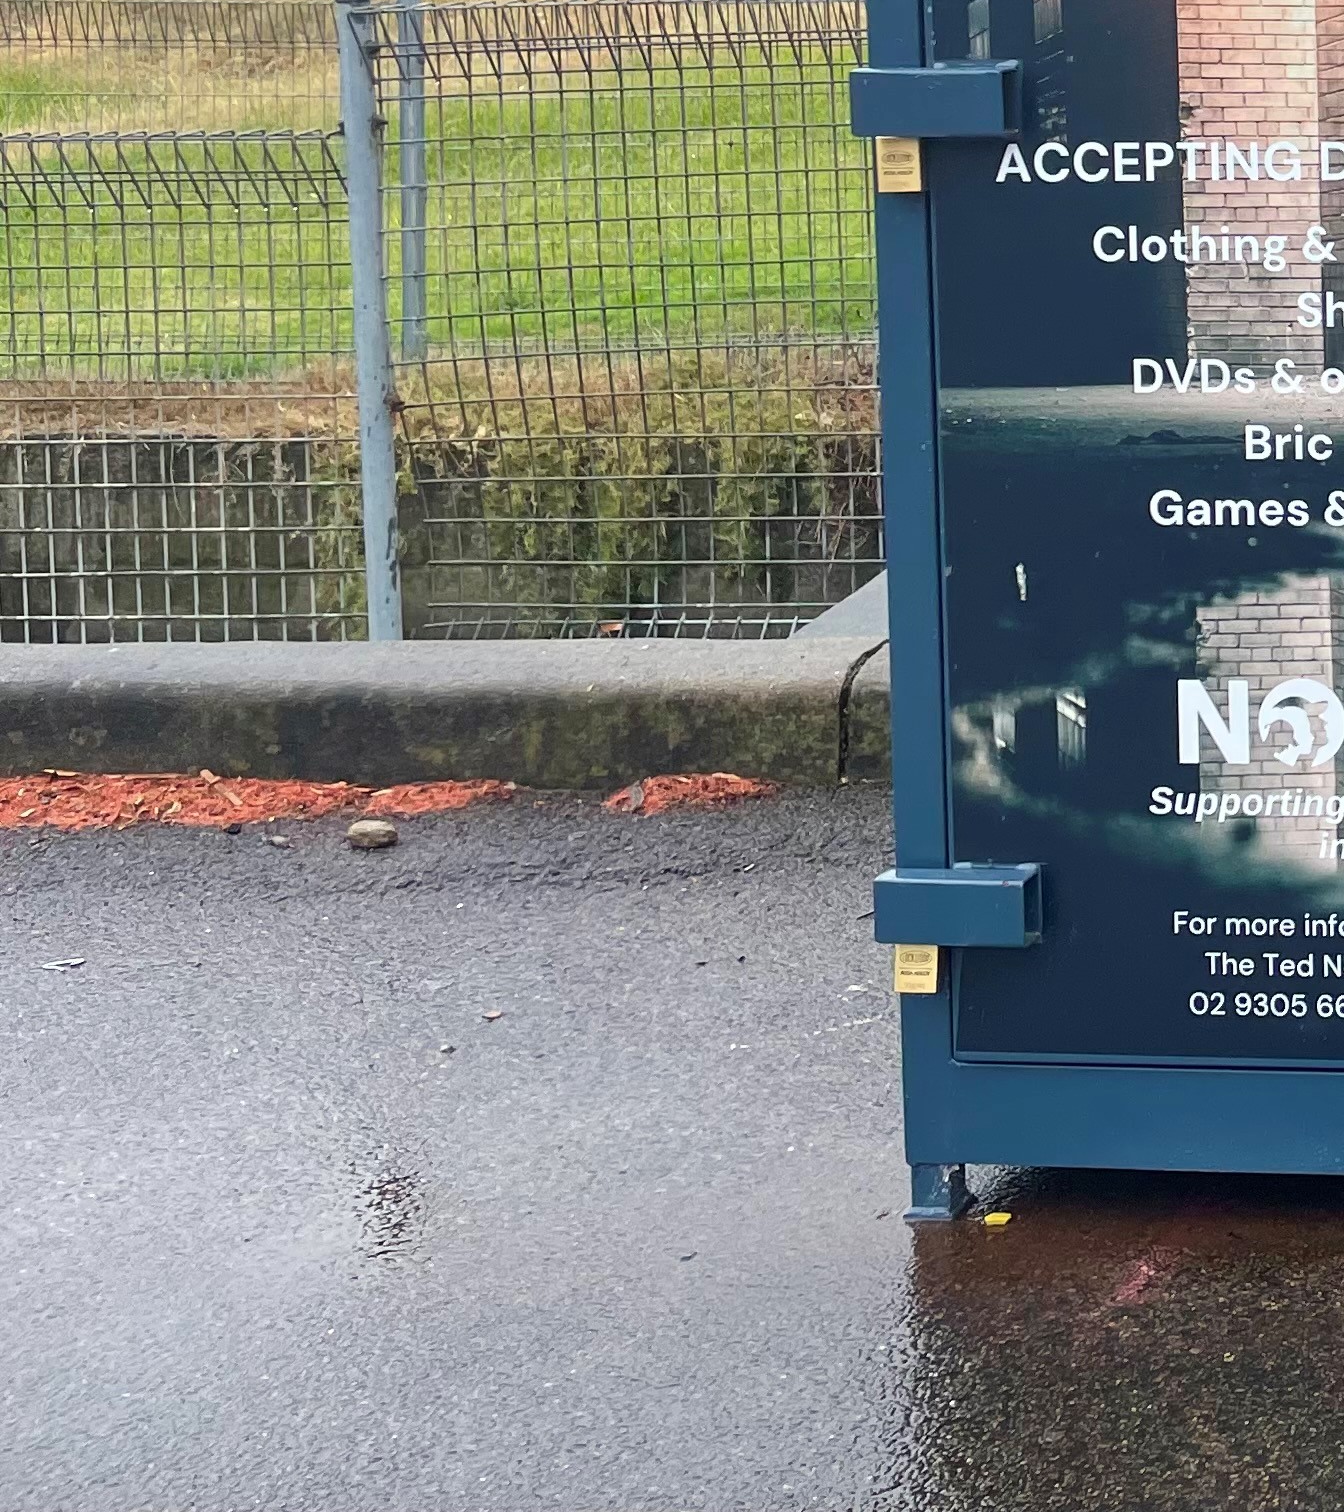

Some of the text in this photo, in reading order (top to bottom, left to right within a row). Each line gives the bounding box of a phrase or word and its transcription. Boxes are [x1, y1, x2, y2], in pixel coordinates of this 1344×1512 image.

[995, 140, 1301, 183] ACCEPTING
[1092, 225, 1288, 272] Clothing
[1301, 225, 1337, 262] &
[1131, 357, 1256, 394] DVDs
[1270, 358, 1304, 395] &
[1244, 424, 1333, 461] Bric
[1148, 489, 1310, 528] Games
[1173, 910, 1217, 936] For
[1225, 918, 1296, 937] more
[1205, 951, 1255, 977] The
[1263, 952, 1314, 978] Ted
[1189, 992, 1226, 1017] 02
[1235, 993, 1308, 1018] 9305
